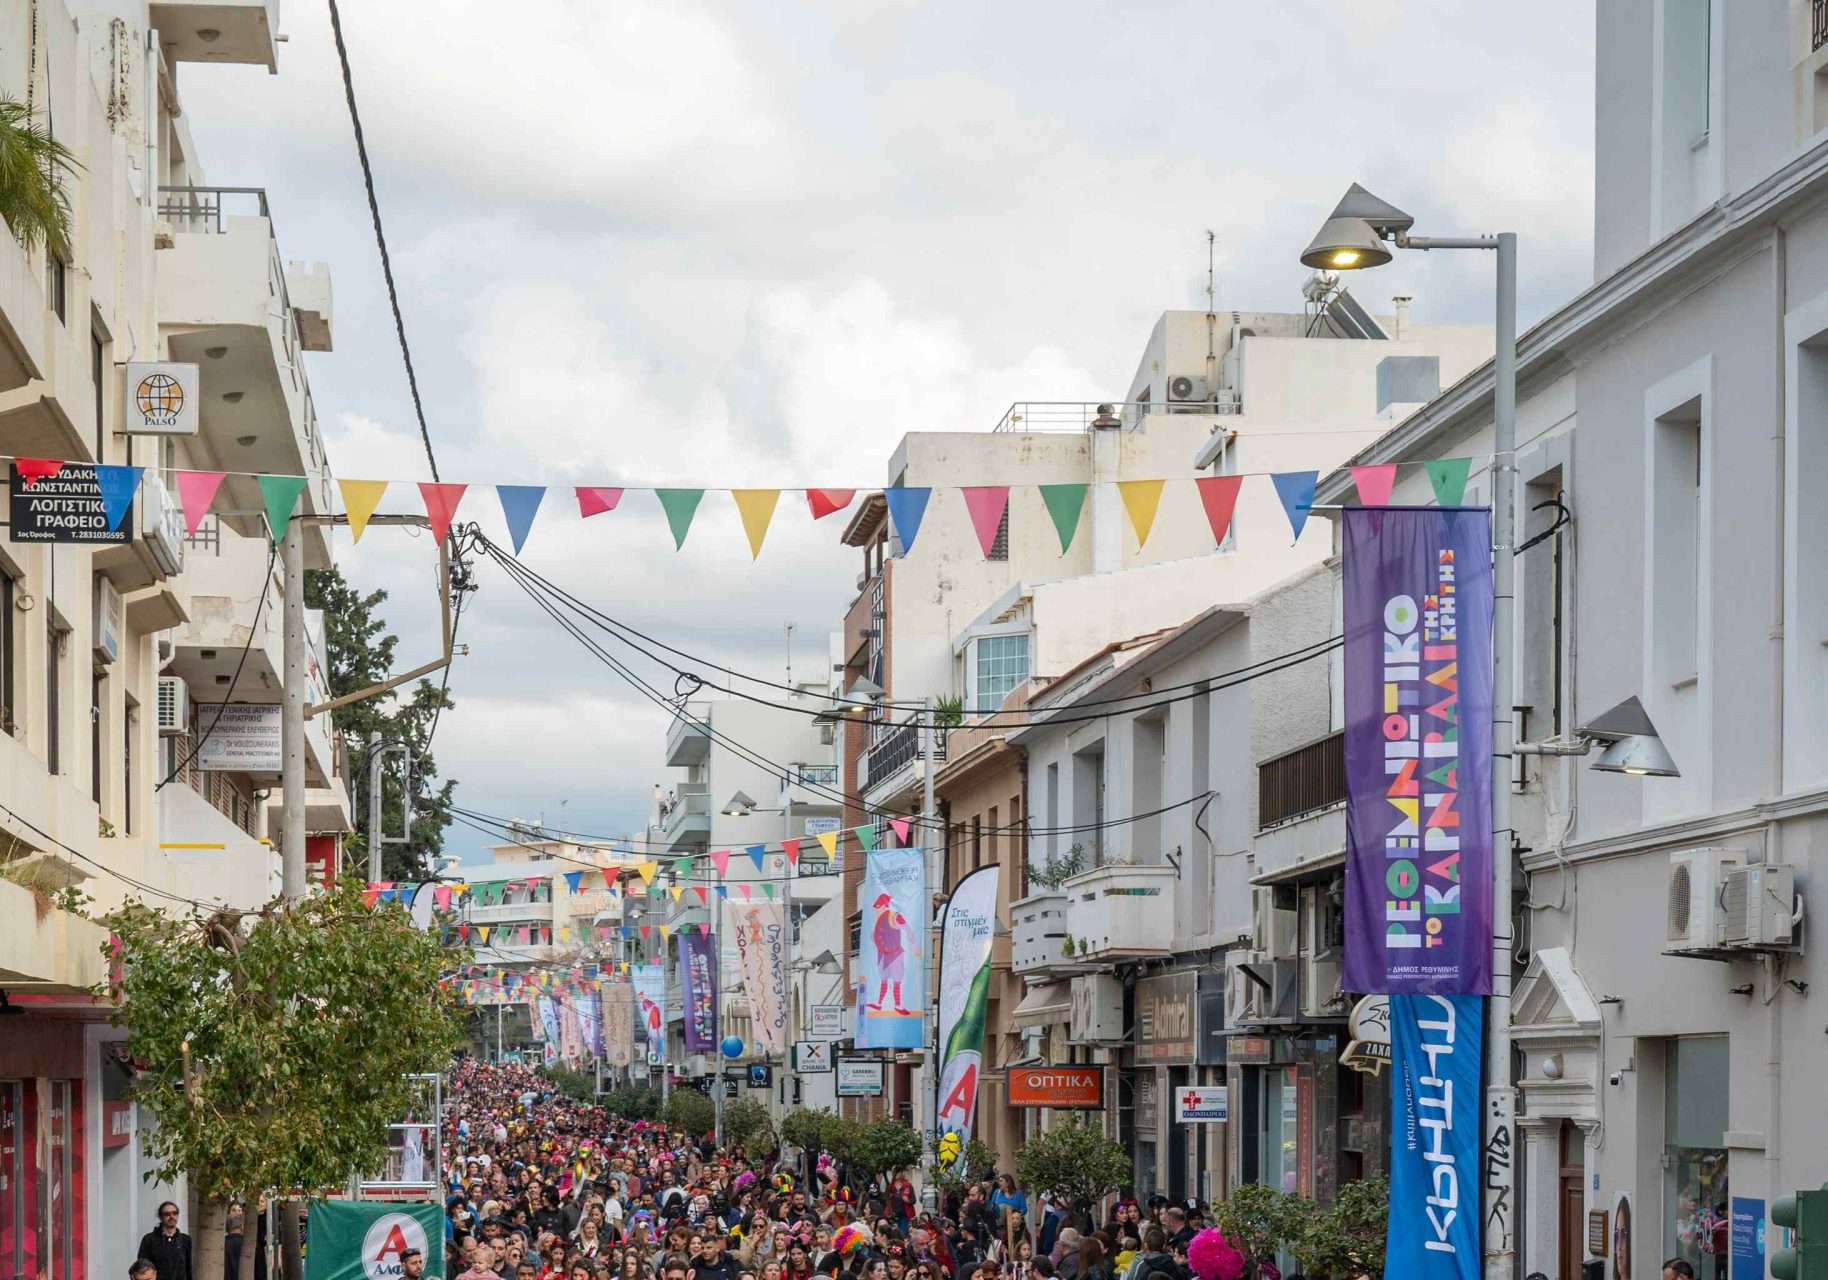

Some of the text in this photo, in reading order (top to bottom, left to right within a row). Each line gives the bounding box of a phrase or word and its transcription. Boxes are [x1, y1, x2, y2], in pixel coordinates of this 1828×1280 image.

[30, 499, 112, 514] ΛΟΓΙΣΤΙΚΟ
[36, 515, 106, 530] ΓΡΑΦΕΙΟ
[1439, 549, 1457, 640] ΚΡΗΤΗΣ
[1424, 595, 1439, 641] ΤΗΣ
[1383, 594, 1421, 948] ΡΕΘΕΜΝΙΩΤΙΚΟ
[1424, 644, 1461, 948] ΤΟ ΚΑΡΝΑΒΑΛΙ
[1154, 993, 1189, 1040] Admiral
[1028, 1075, 1094, 1088] ΟΠΤΙΚΑ
[374, 1264, 404, 1275] ΑΛΦ
